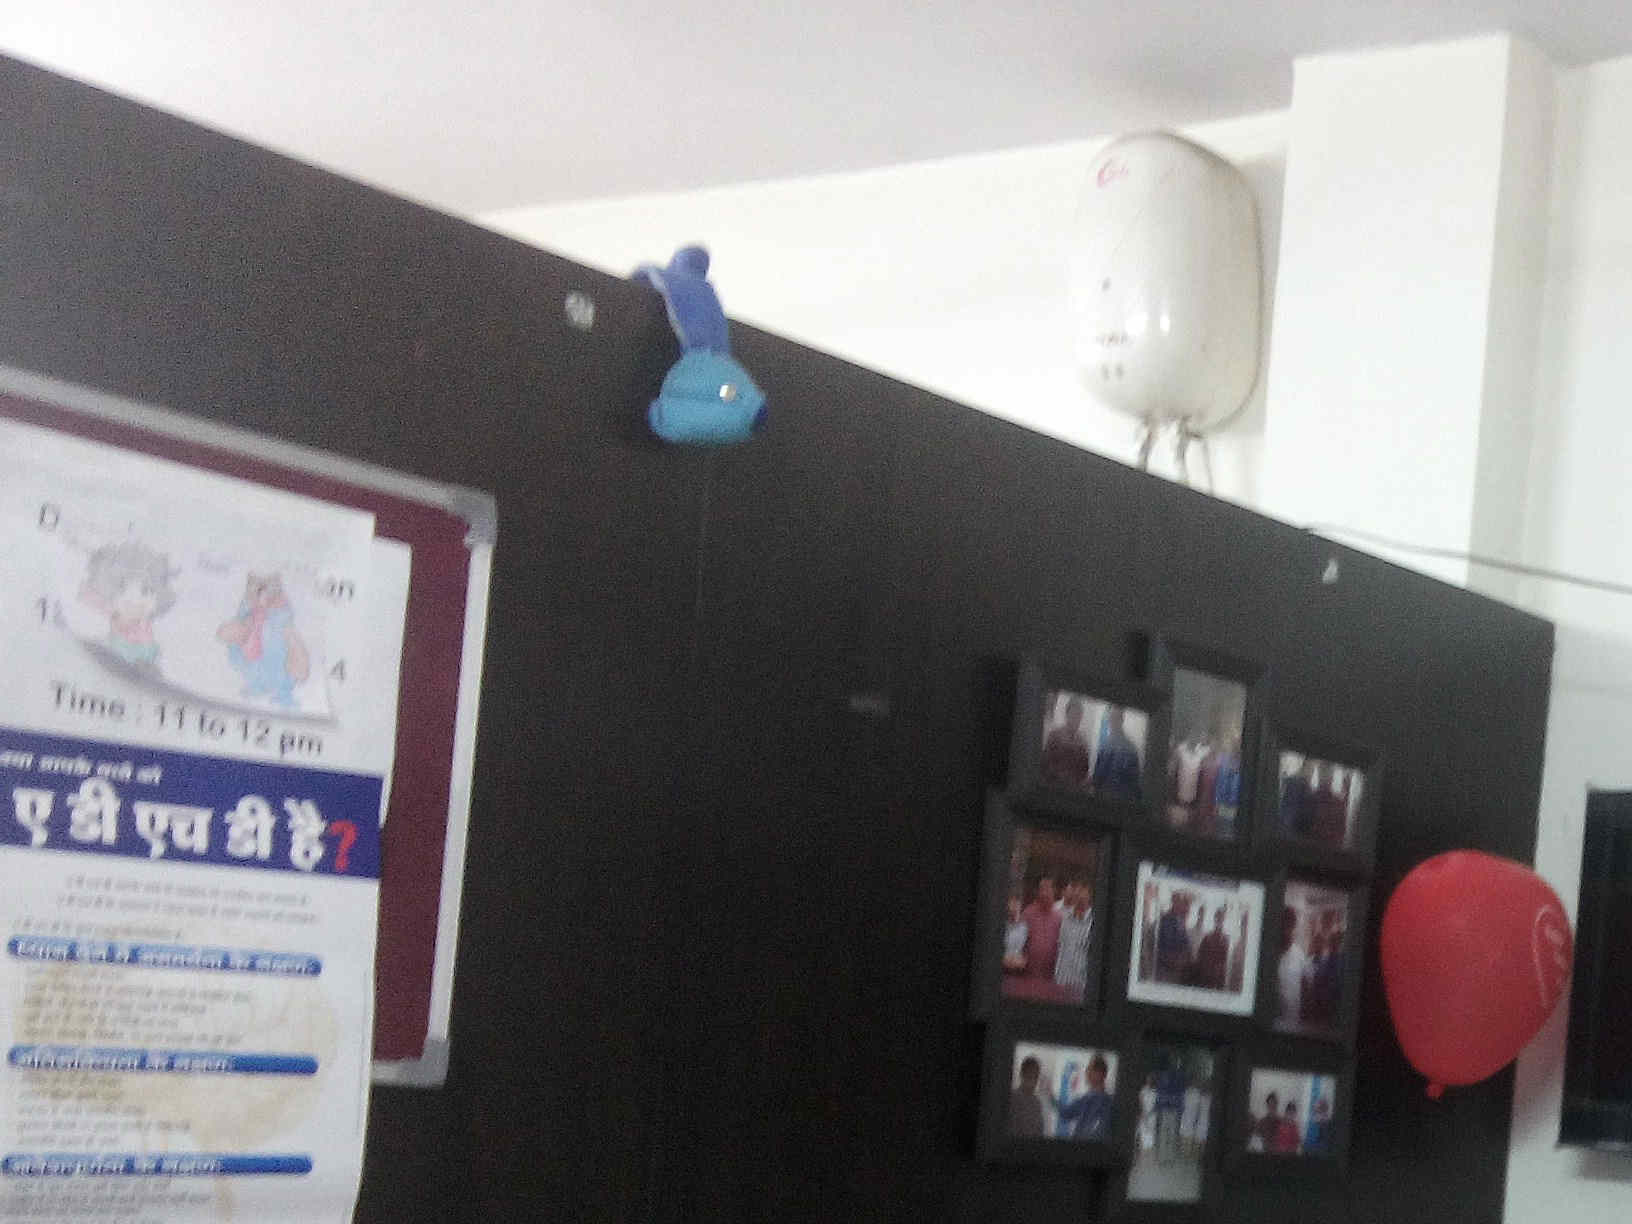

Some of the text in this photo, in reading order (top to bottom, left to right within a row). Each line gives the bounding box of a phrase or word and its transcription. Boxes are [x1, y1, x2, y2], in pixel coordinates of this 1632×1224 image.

[52, 682, 126, 721] Time
[157, 703, 188, 732] 11
[198, 711, 226, 738] to
[239, 717, 271, 748] 12
[279, 729, 323, 756] pm
[12, 785, 56, 849] ए
[66, 774, 121, 847] डी
[224, 794, 277, 861] डी
